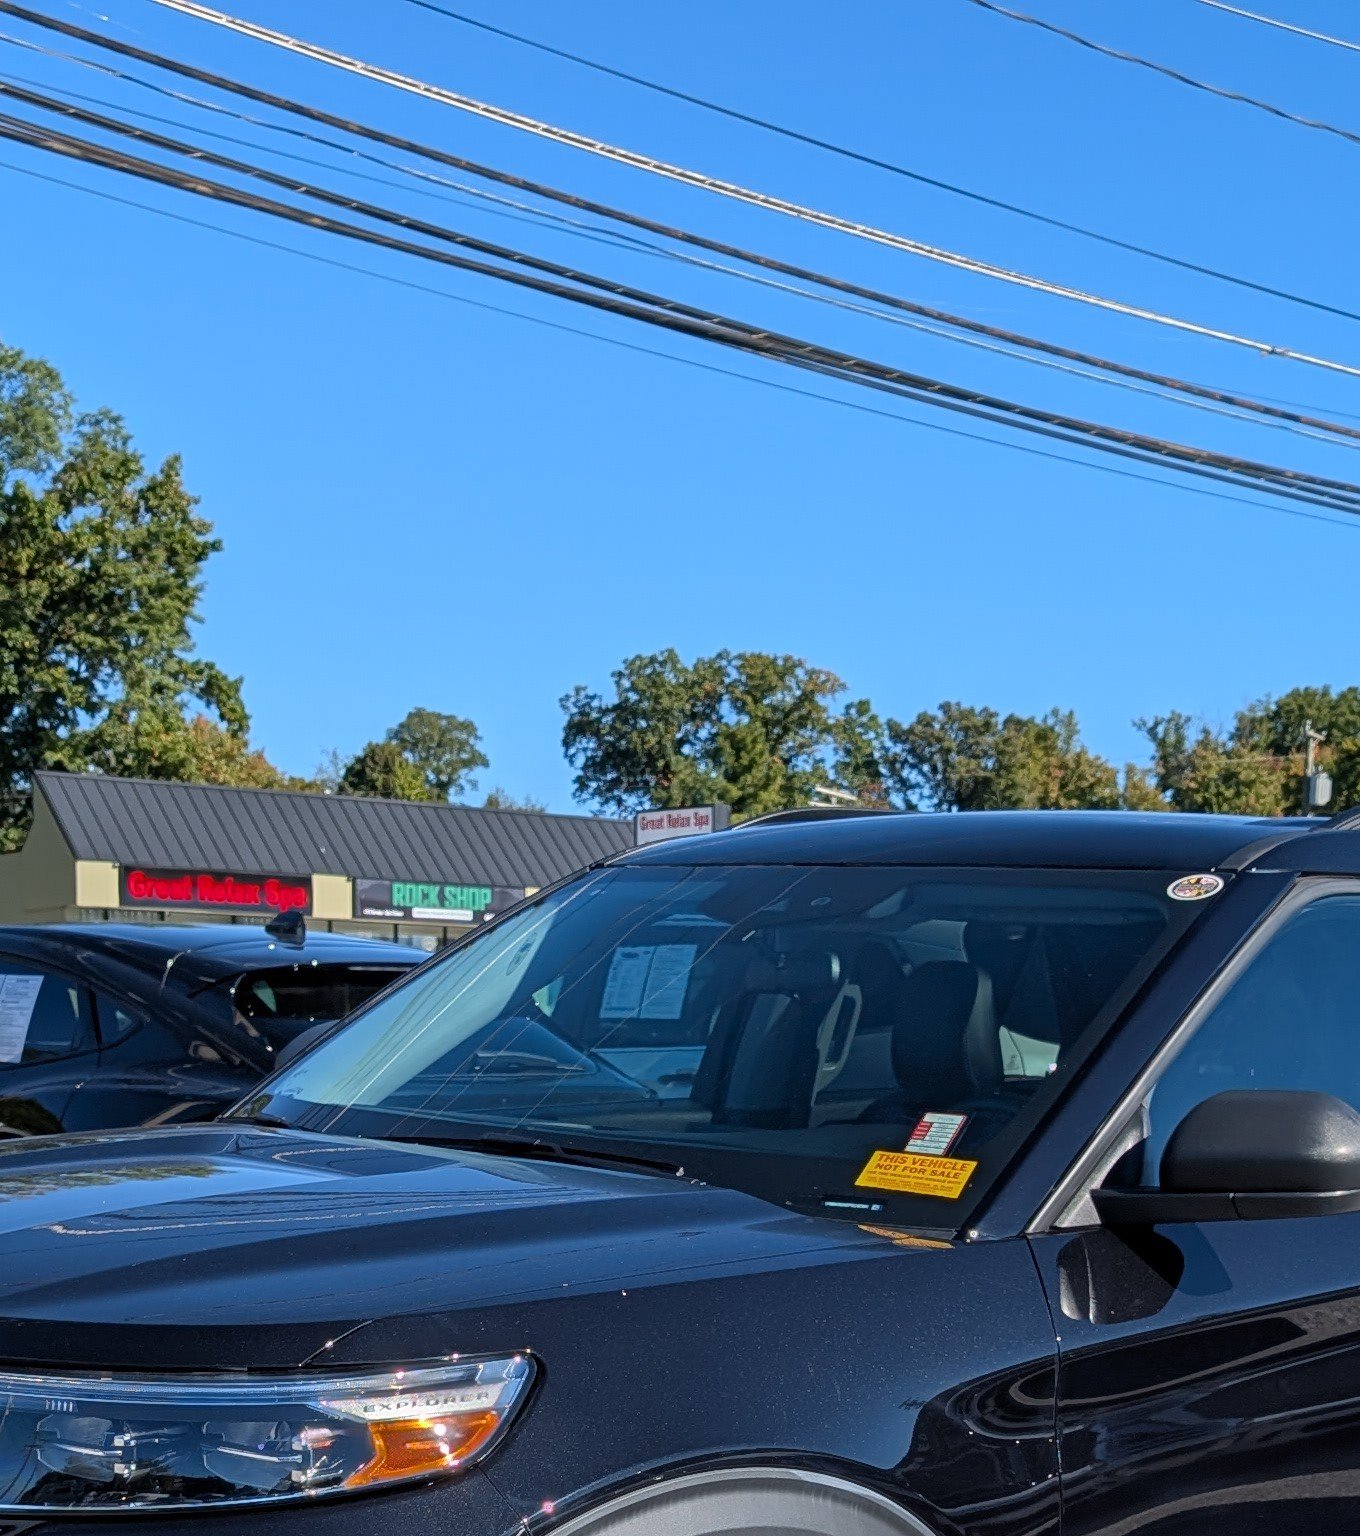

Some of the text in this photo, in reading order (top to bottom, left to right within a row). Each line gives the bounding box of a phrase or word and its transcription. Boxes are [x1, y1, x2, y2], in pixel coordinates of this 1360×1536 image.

[693, 812, 709, 830] Spa
[127, 870, 308, 912] Great Relax Spa
[391, 882, 492, 911] ROCK SHOP
[874, 1162, 901, 1172] NOT
[901, 1165, 927, 1176] FOR
[929, 1168, 962, 1180] SALE
[878, 1153, 971, 1172] THIS VEHICLE
[363, 1391, 490, 1413] EXPLORER
